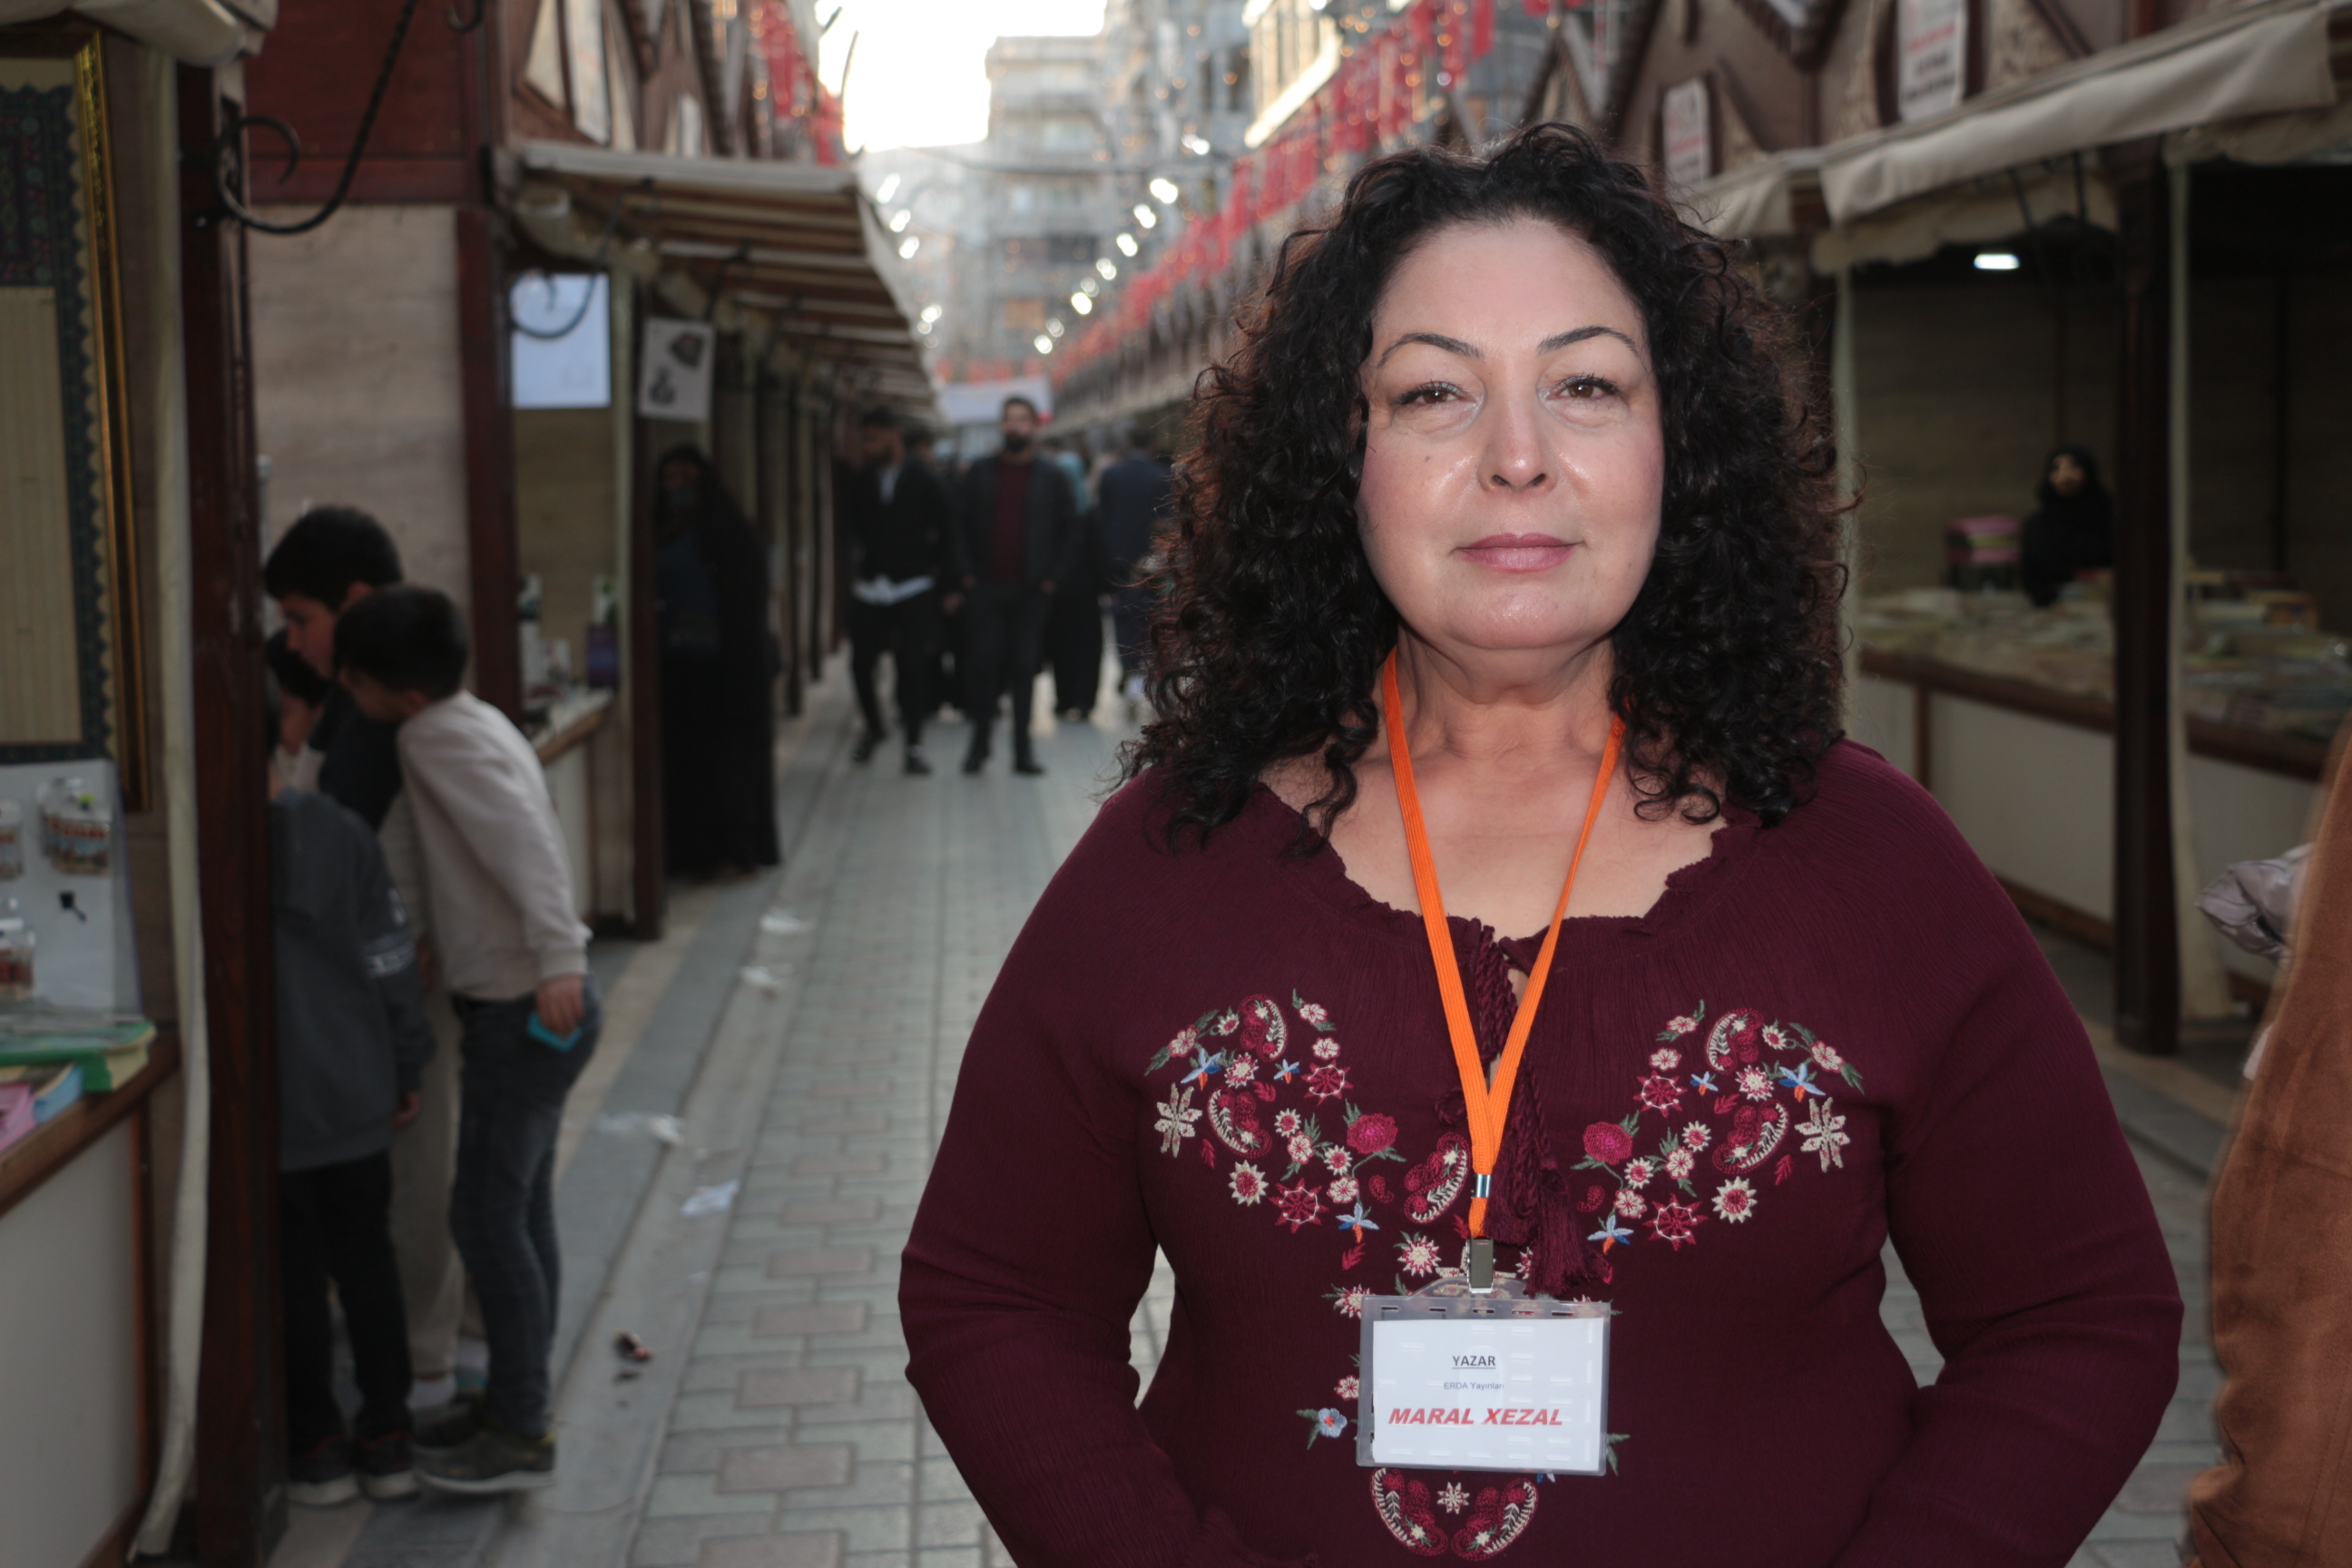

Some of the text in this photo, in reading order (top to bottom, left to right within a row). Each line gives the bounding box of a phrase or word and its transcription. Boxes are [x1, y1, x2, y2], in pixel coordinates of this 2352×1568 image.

[1452, 1355, 1496, 1367] YAZAR
[1443, 1381, 1468, 1390] ERDA
[1387, 1407, 1563, 1426] MARAL XEZAL
